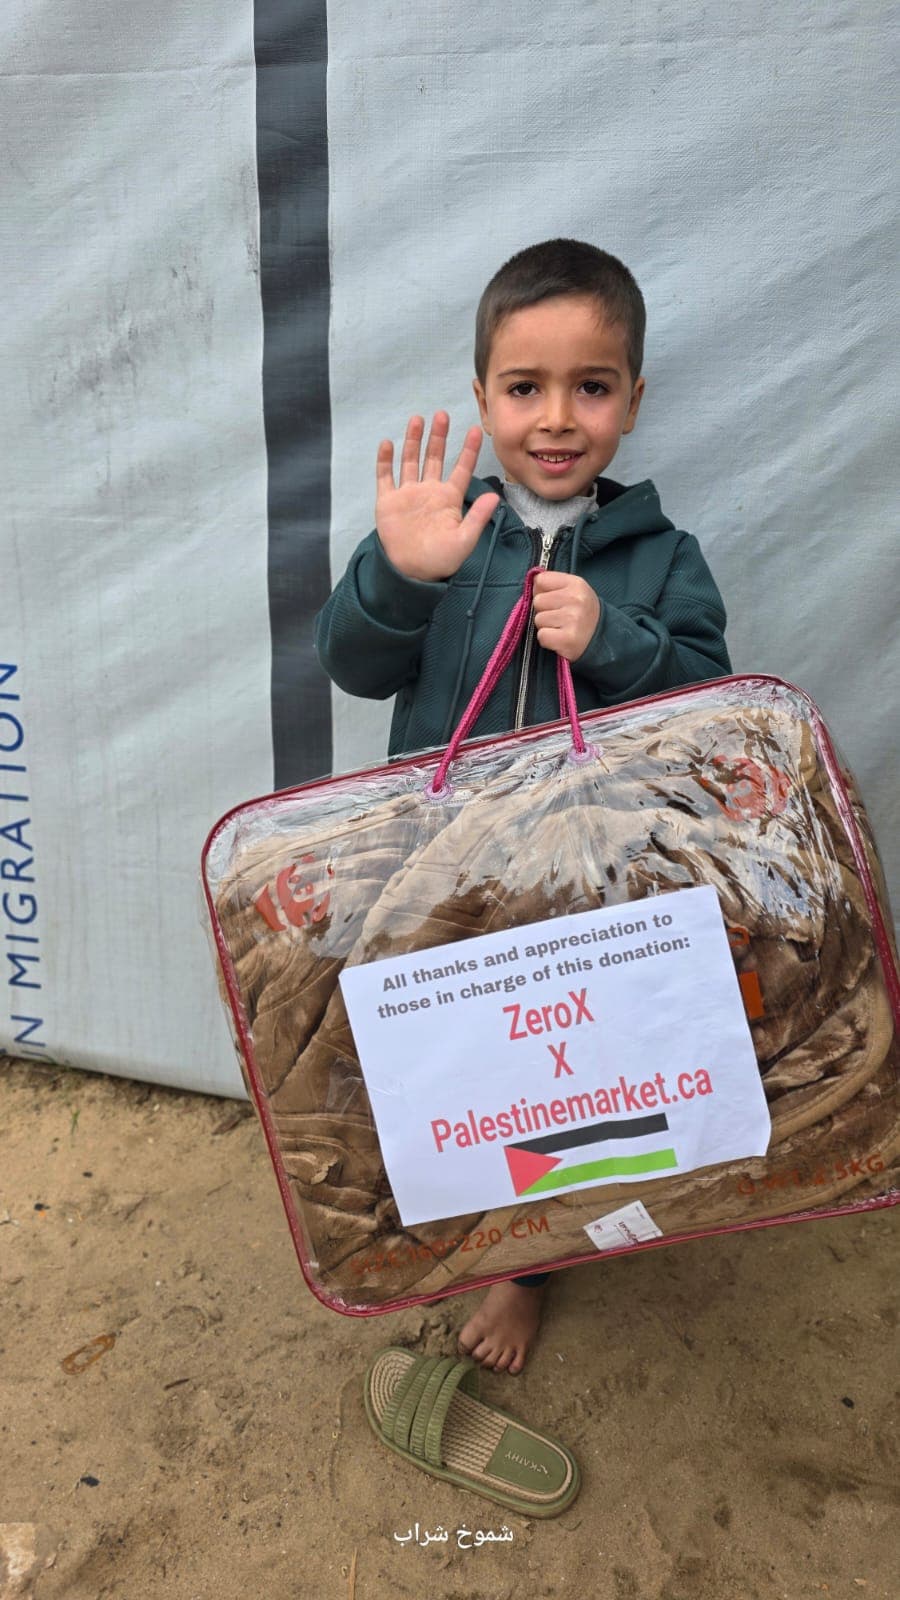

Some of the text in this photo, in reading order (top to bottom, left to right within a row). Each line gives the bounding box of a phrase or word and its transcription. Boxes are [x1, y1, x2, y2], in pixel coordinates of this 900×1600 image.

[377, 937, 691, 1019] those in charge of this donation:
[382, 912, 673, 992] All thanks and appreciation to
[503, 988, 594, 1041] ZeroX
[547, 1042, 574, 1079] X
[430, 1068, 713, 1153] Palestinemarket.ca
[510, 1216, 550, 1240] CM
